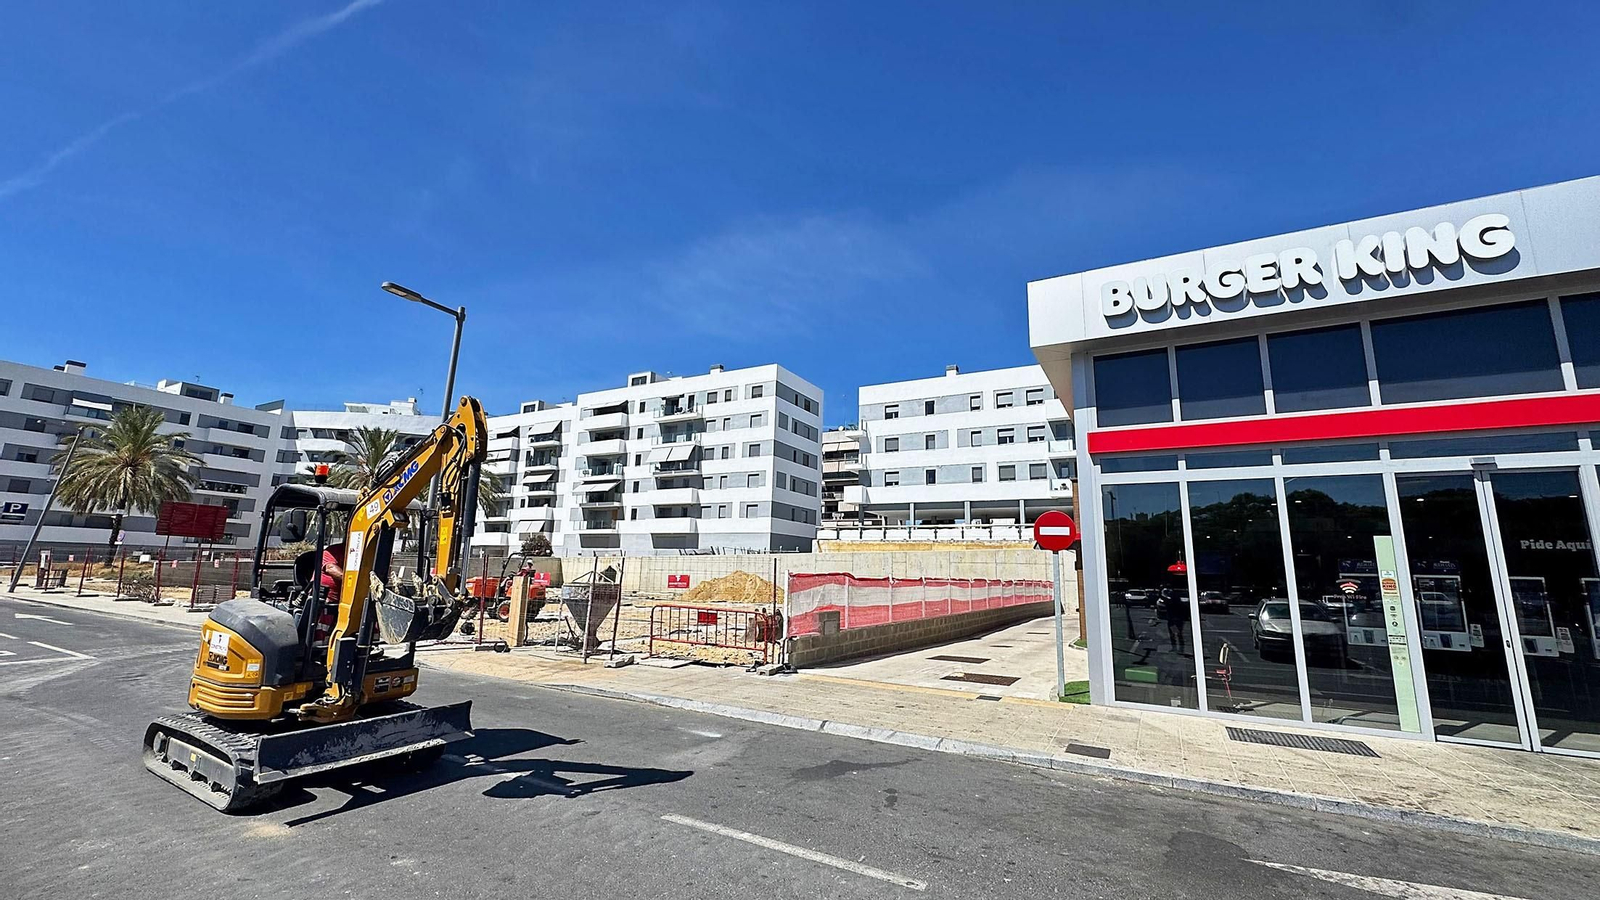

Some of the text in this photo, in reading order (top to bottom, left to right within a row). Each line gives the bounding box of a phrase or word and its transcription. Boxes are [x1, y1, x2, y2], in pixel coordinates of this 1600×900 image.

[1100, 213, 1516, 317] BURGER KING
[9, 503, 22, 513] P
[369, 501, 379, 513] 49
[1520, 539, 1554, 549] Pide
